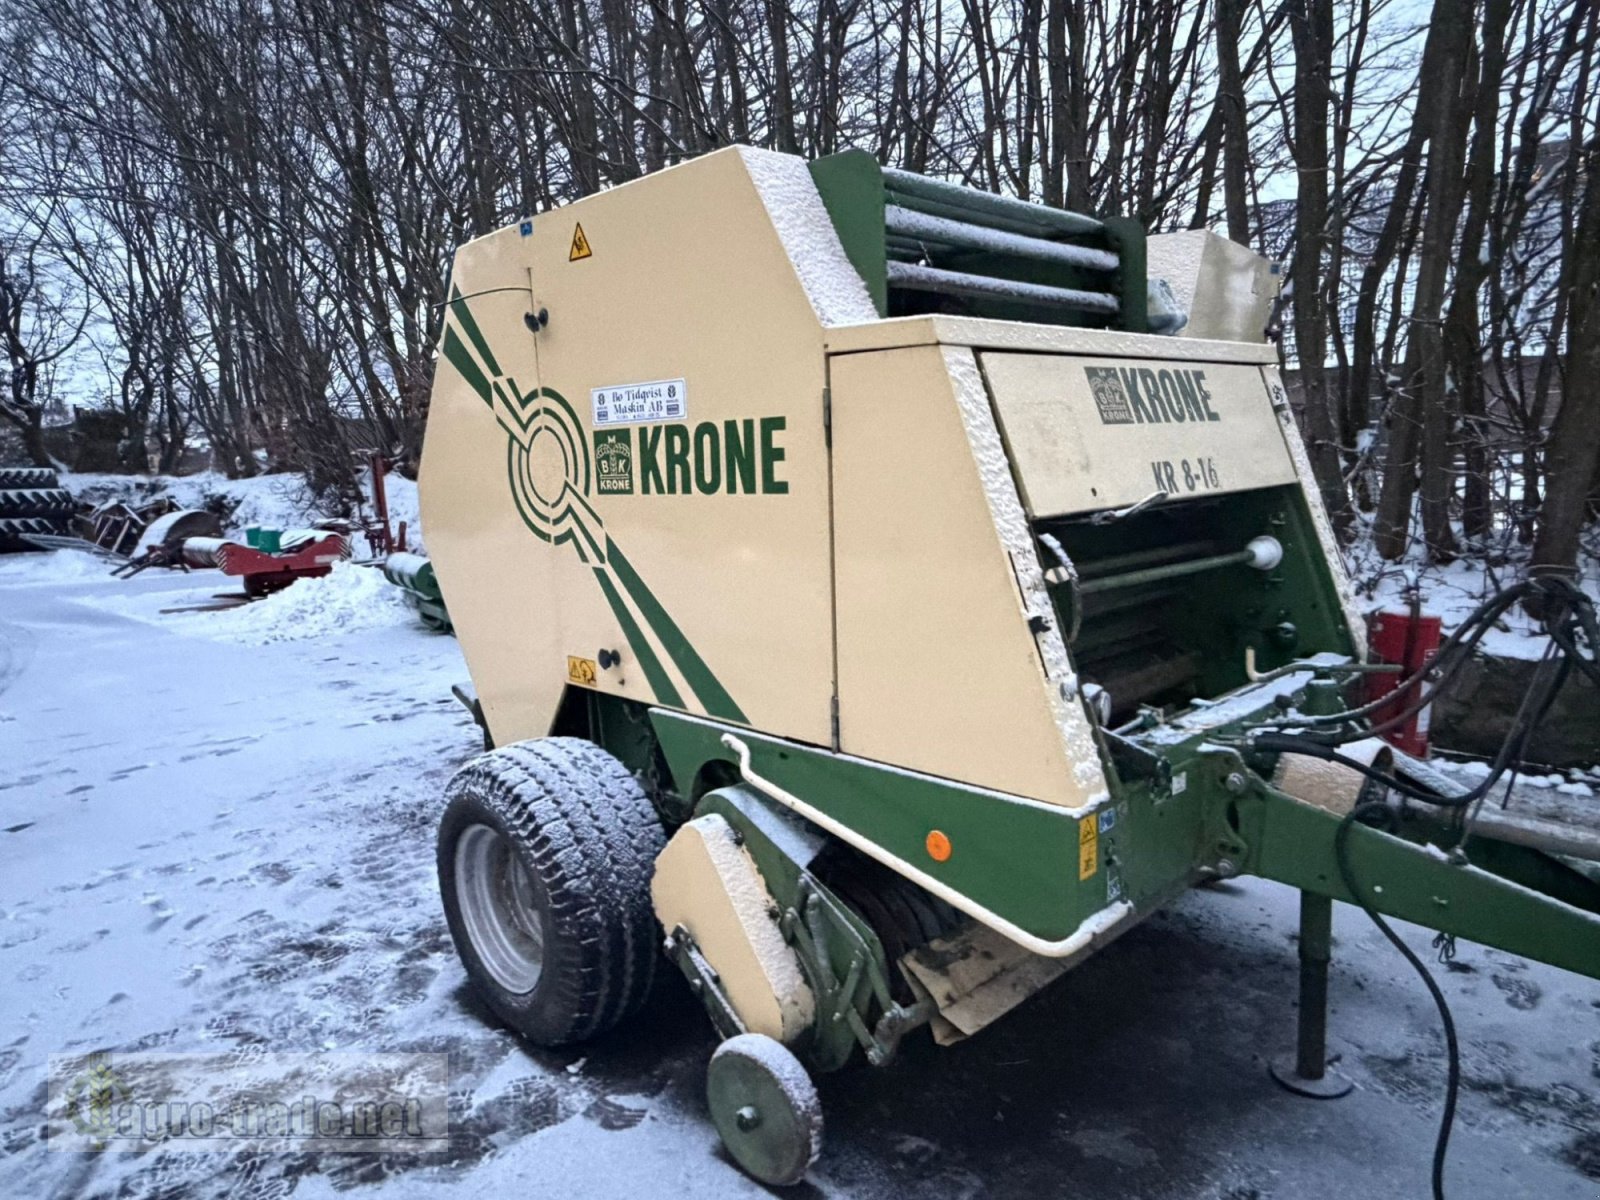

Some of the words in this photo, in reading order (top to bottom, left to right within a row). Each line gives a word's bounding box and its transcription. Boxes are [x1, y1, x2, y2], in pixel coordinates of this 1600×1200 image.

[612, 391, 623, 402] Bo
[1119, 367, 1221, 424] KRONE
[613, 402, 645, 414] Maskin
[648, 400, 663, 412] AB
[638, 416, 789, 495] KRONE
[601, 460, 609, 474] B
[618, 459, 626, 473] K
[1151, 461, 1179, 494] KR
[1181, 457, 1219, 492] 8-16
[600, 479, 630, 490] KRONE
